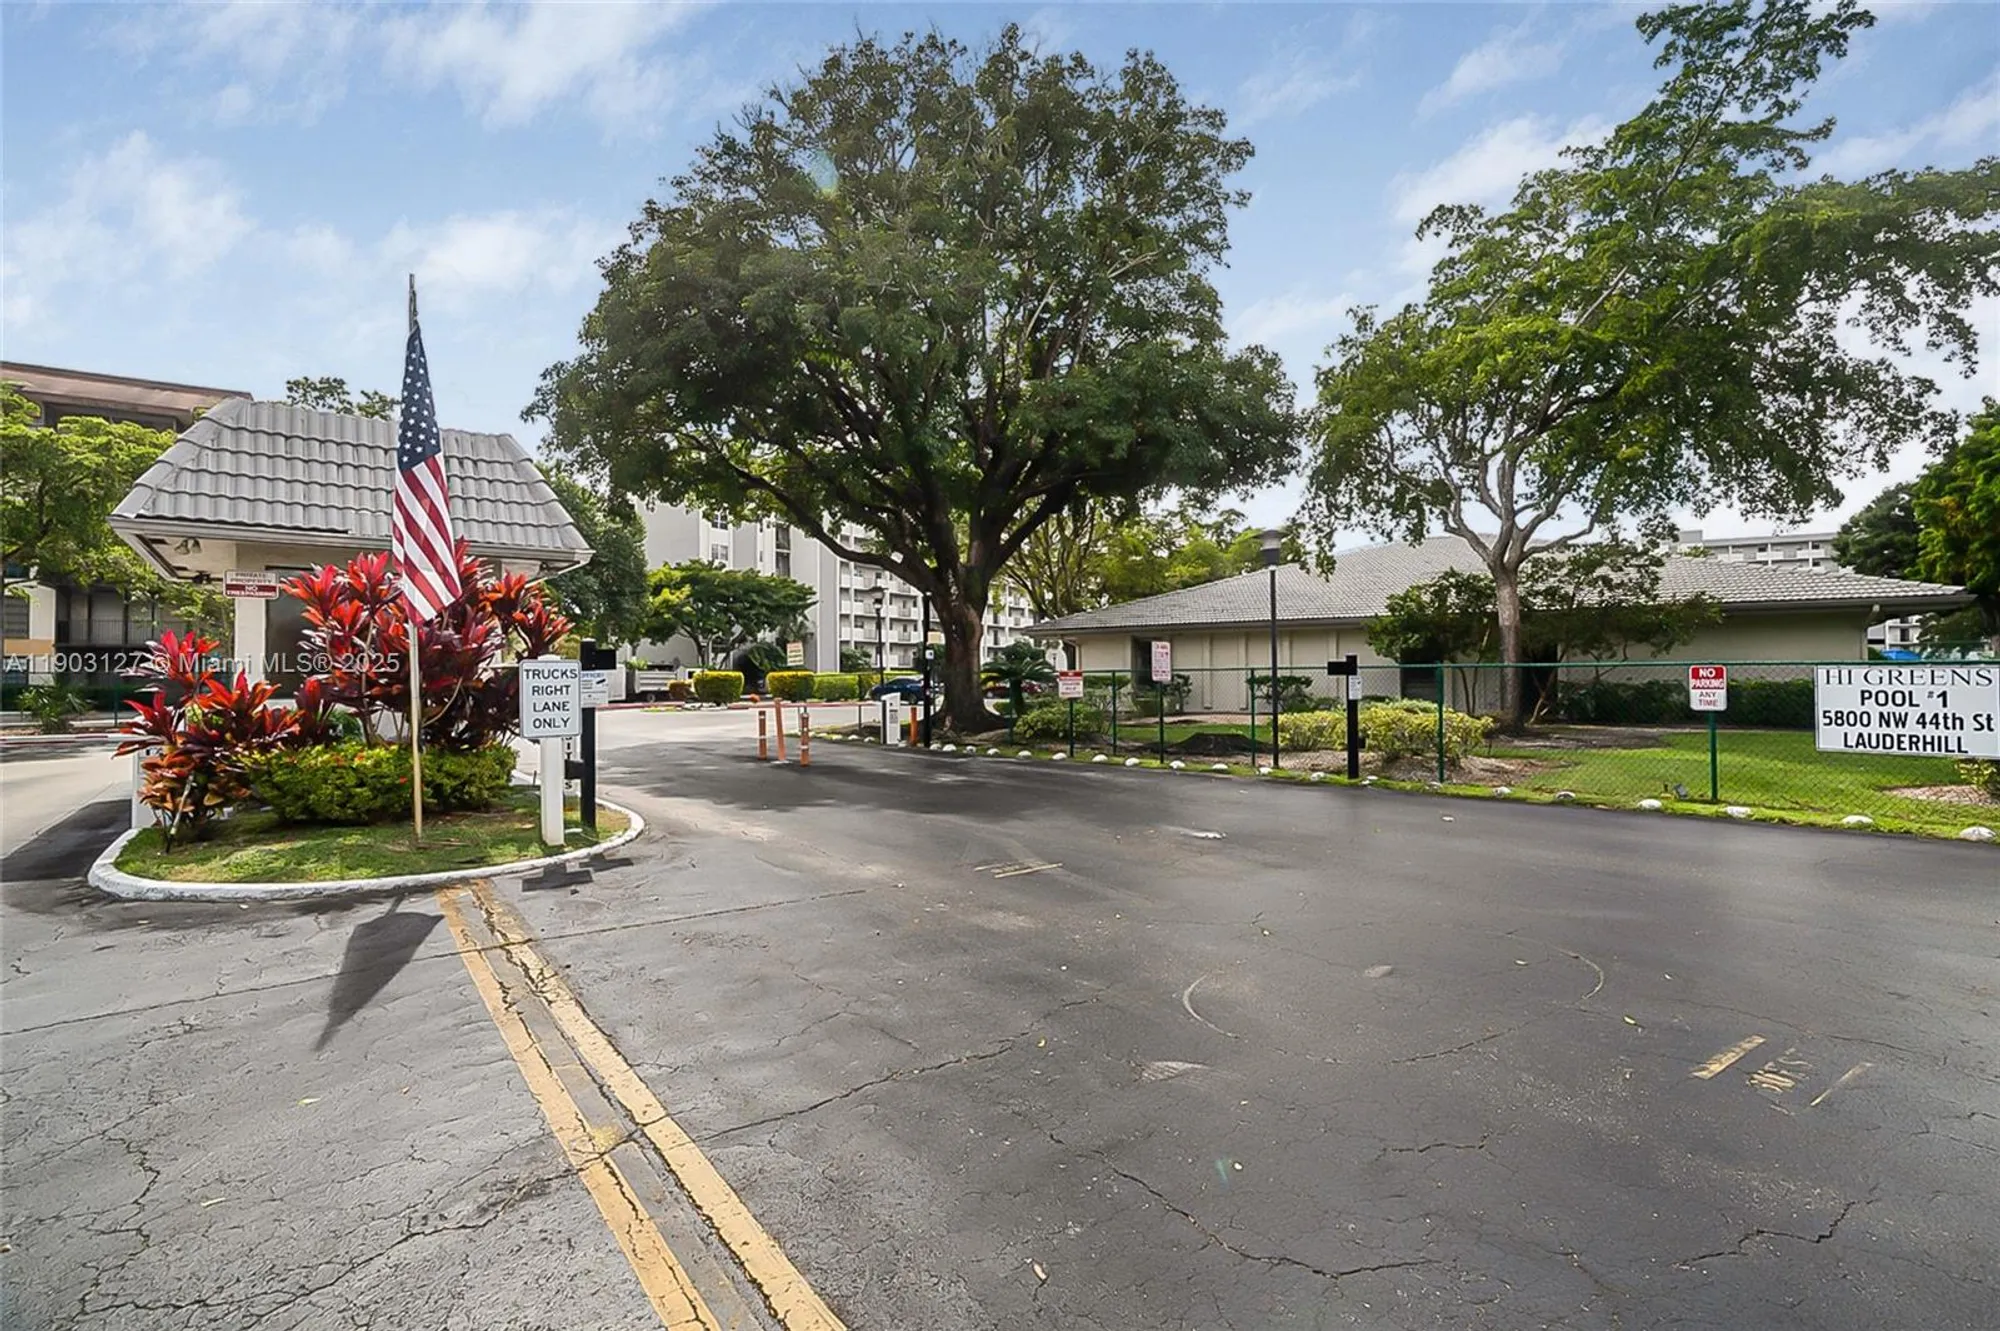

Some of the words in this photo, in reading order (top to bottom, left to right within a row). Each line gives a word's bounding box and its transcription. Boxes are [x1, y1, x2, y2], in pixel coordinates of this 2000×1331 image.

[524, 669, 578, 680] TRUCKS
[1699, 668, 1716, 678] NO
[1825, 669, 1852, 685] HI
[1863, 668, 1993, 687] GREENS
[1692, 679, 1725, 689] PARKING
[532, 685, 571, 696] RIGHT
[1699, 699, 1719, 707] TIME
[1860, 690, 1920, 708] POOL
[1926, 690, 1948, 708] #1
[533, 701, 570, 713] LANE
[532, 717, 571, 729] ONLY
[1823, 710, 1871, 727] 5800
[1878, 711, 1908, 728] NW
[1915, 712, 1964, 731] 44th
[1973, 713, 1995, 732] St
[1844, 732, 1968, 754] LAUDERHILL
